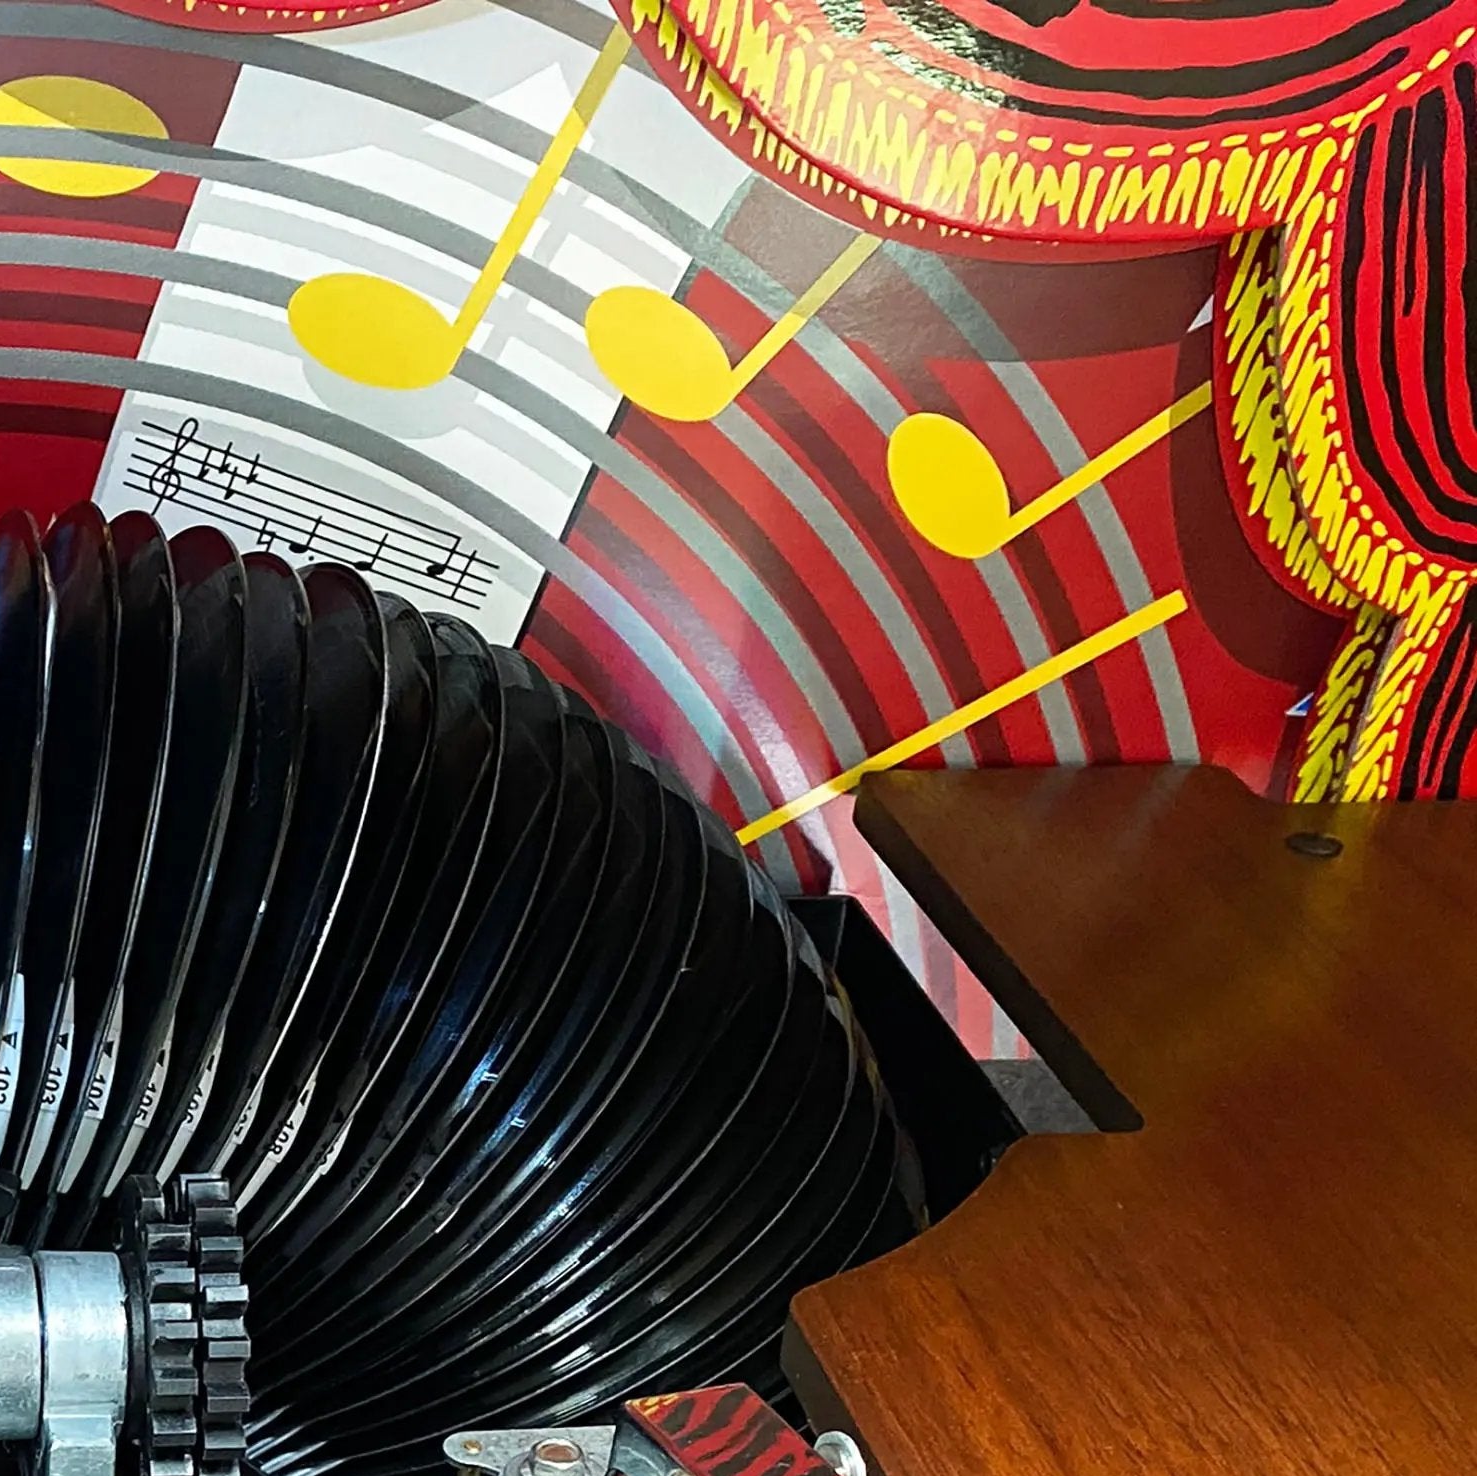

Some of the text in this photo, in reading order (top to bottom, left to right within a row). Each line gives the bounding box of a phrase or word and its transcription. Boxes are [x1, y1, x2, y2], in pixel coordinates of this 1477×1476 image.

[41, 1067, 63, 1106] 103
[86, 1074, 107, 1112] 104
[136, 1082, 157, 1121] 105
